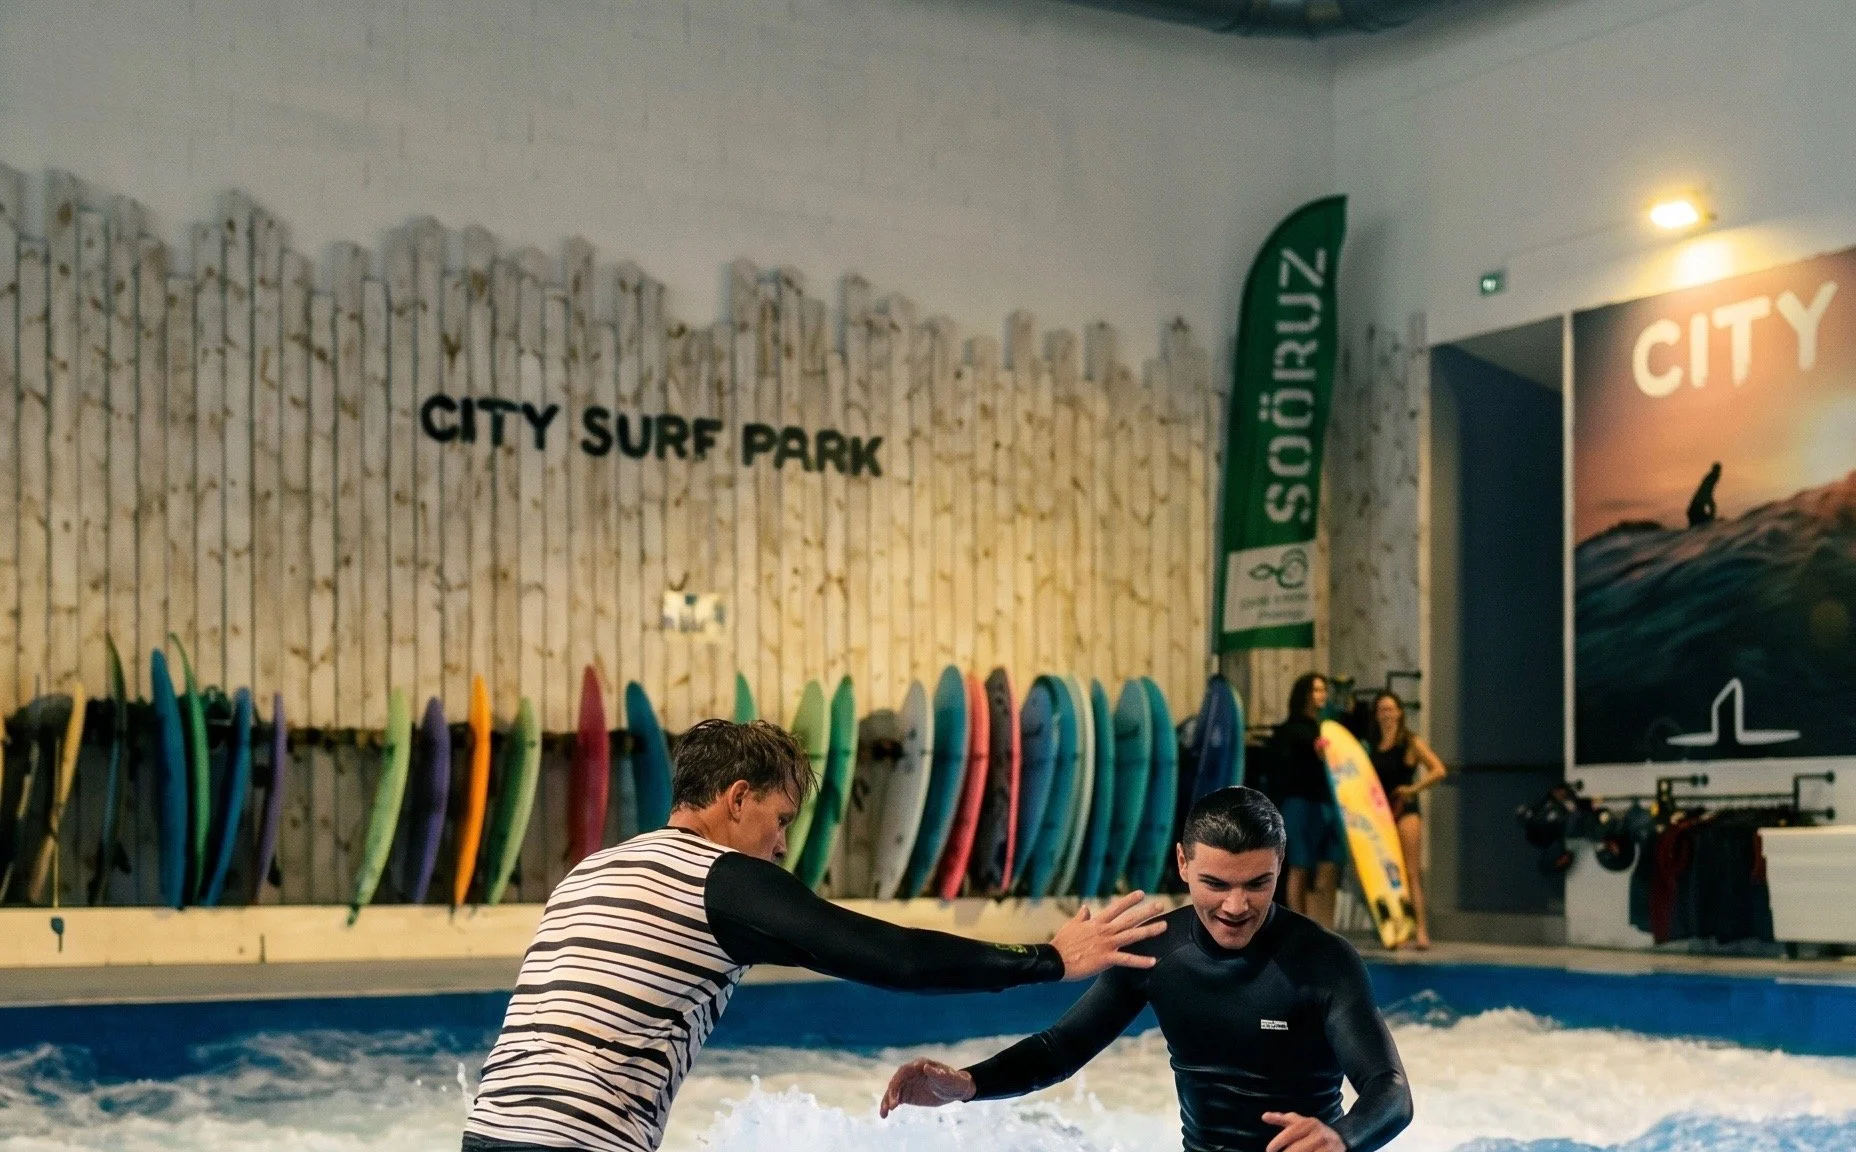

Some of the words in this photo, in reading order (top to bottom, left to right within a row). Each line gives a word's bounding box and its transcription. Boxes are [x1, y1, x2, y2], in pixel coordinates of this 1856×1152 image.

[1258, 247, 1328, 525] SOÖRUZ
[1632, 281, 1839, 398] CITY
[421, 393, 560, 451] CITY
[581, 406, 723, 461] SURF
[743, 422, 885, 477] PARK
